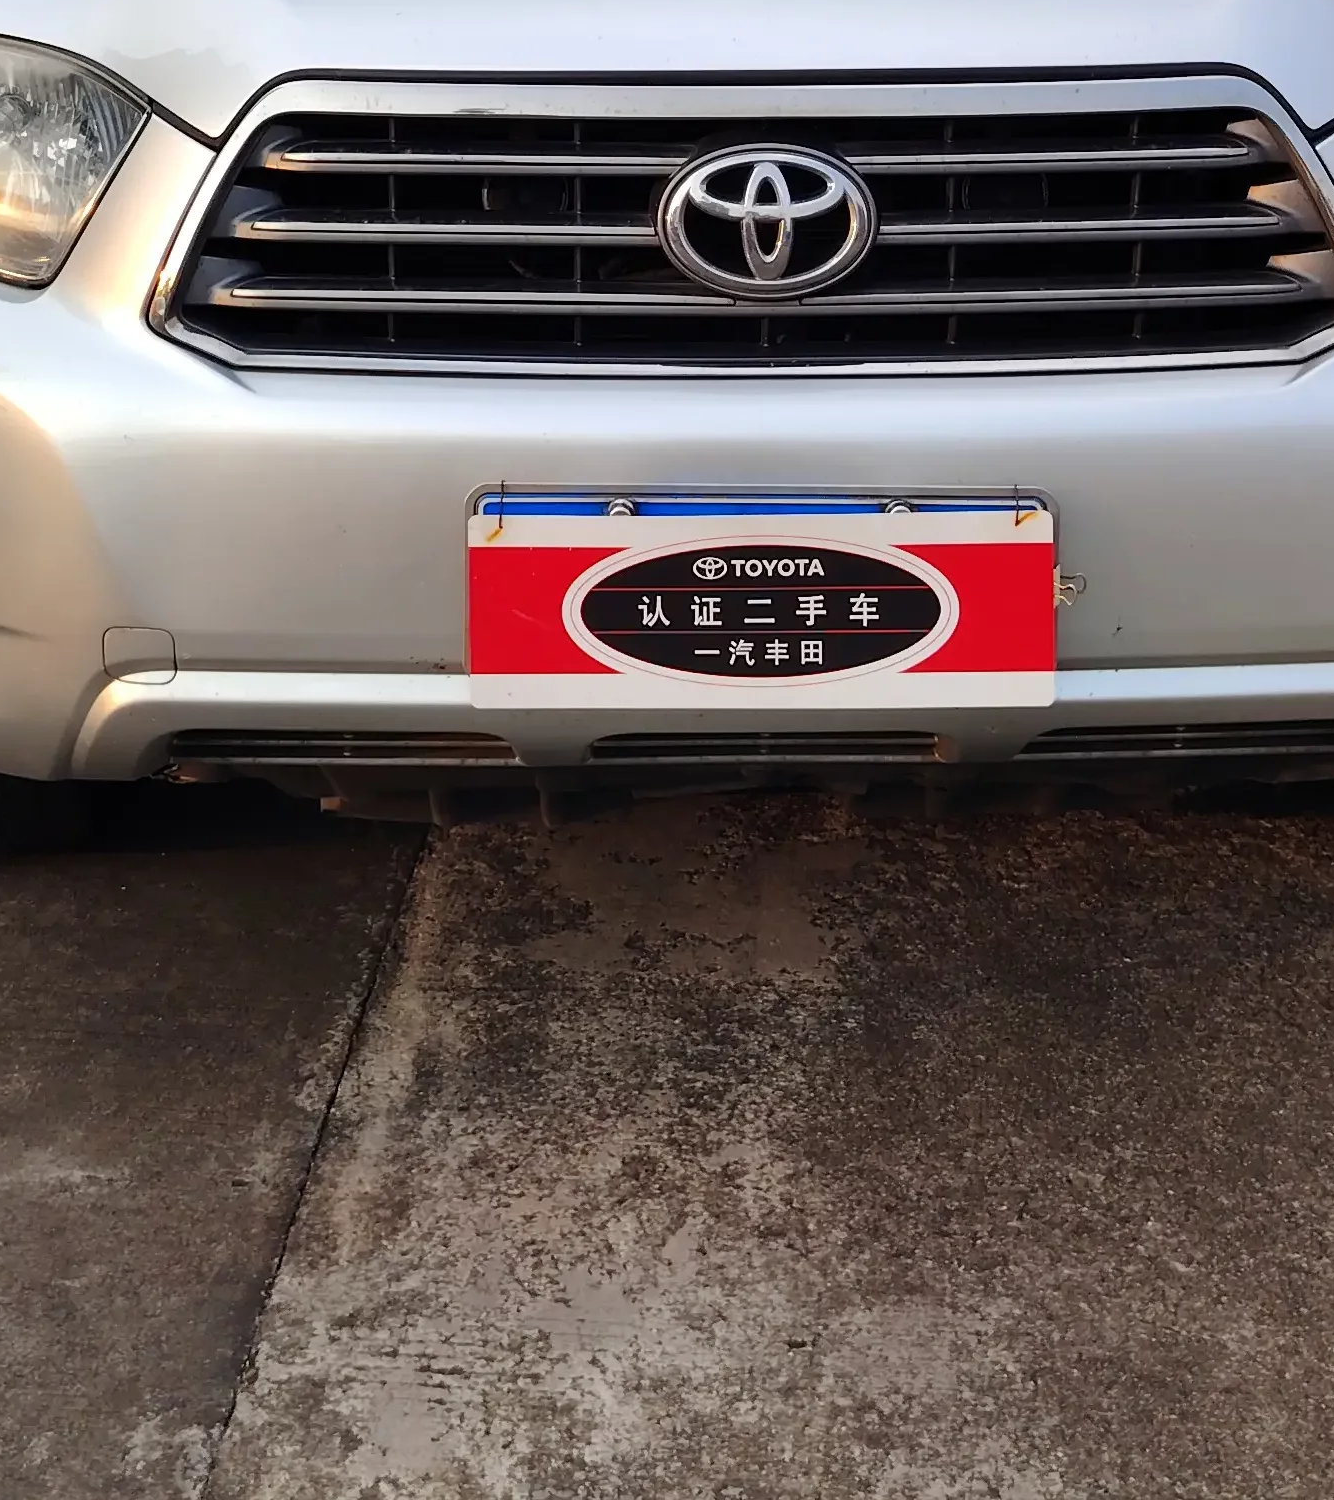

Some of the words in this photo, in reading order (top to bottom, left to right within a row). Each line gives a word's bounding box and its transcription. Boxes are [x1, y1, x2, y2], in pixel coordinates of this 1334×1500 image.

[730, 558, 825, 577] TOYOTA
[638, 592, 880, 628] 认证二手车
[694, 638, 823, 666] 一汽丰田
